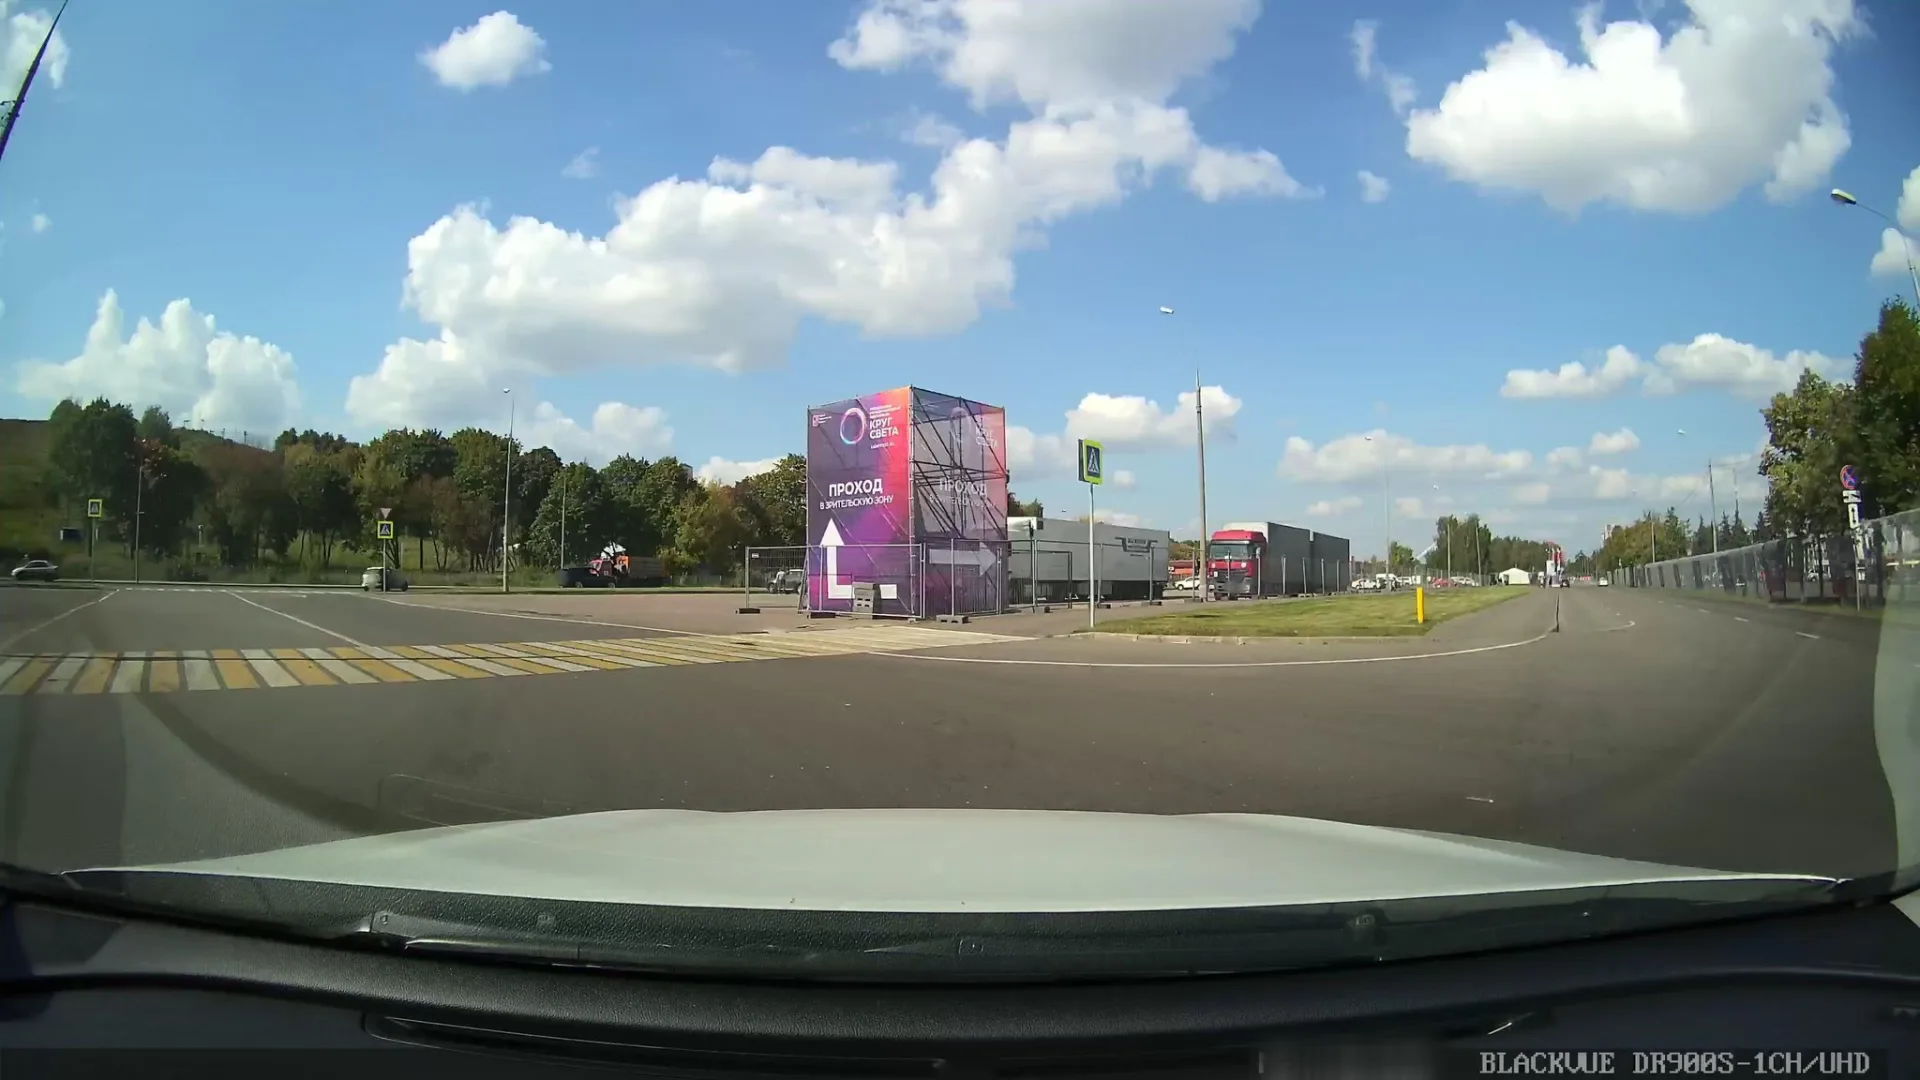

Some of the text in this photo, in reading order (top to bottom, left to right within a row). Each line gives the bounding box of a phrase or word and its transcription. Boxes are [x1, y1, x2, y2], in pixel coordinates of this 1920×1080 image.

[869, 417, 893, 430] КРУГ
[869, 426, 899, 439] СВЕТА
[829, 478, 883, 497] ПРОХОД
[819, 495, 894, 510] В ЗРИТЕЛЬСКУЮ ЗОНУ
